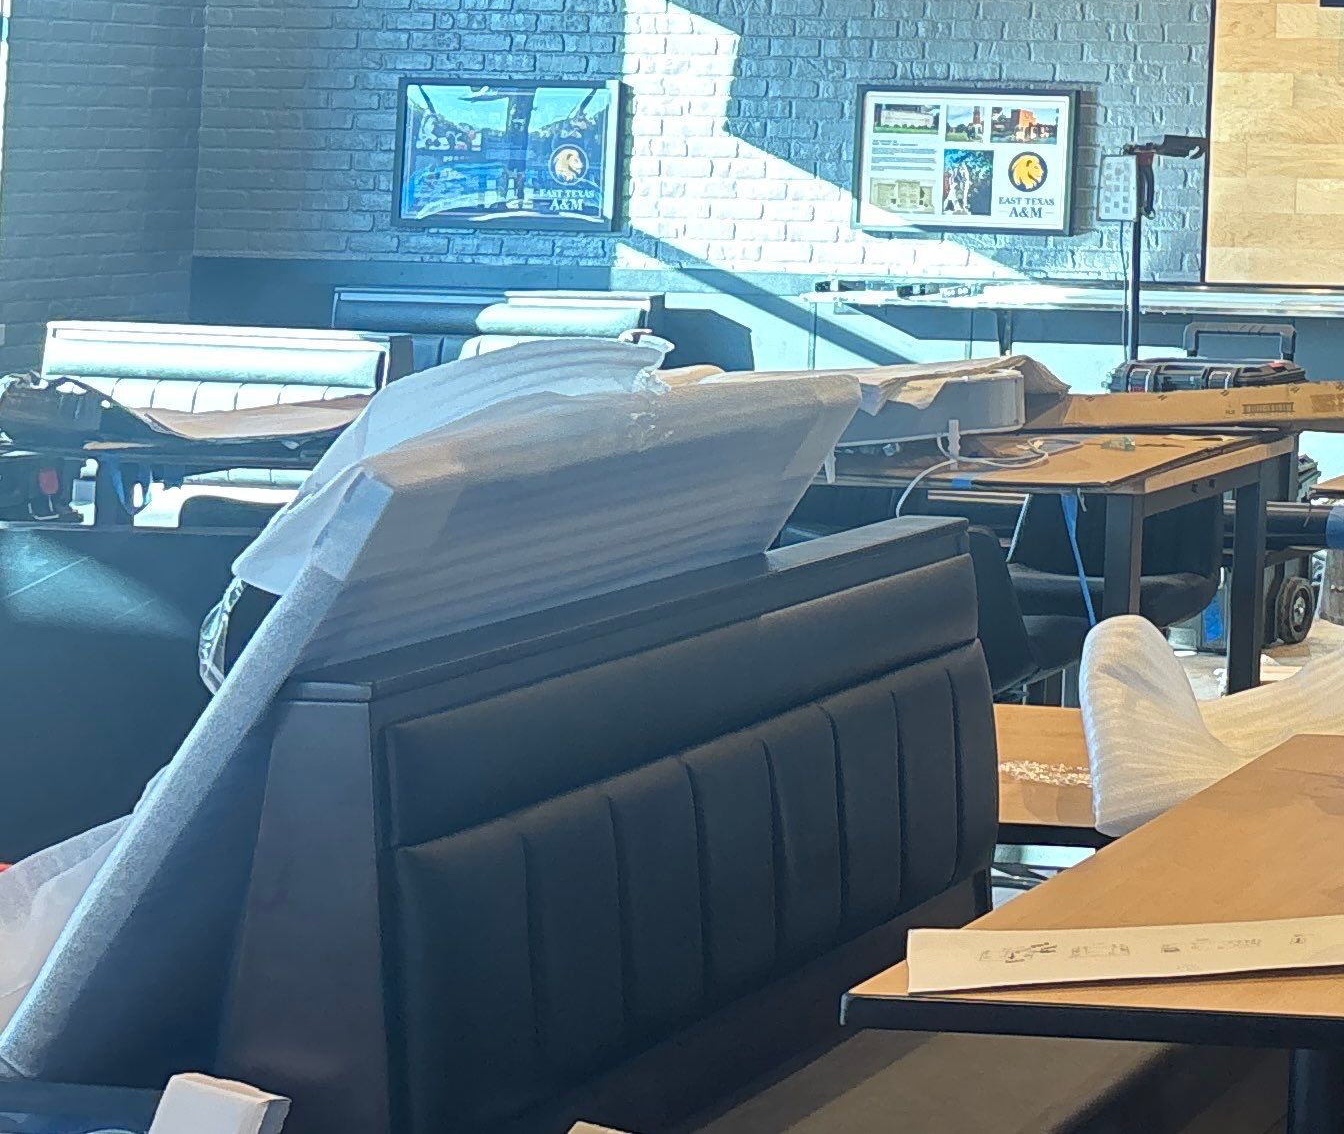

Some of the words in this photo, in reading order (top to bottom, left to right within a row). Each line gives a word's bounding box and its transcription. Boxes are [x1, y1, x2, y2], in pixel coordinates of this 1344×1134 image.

[539, 188, 564, 198] EAST
[549, 198, 584, 211] A&M
[998, 196, 1022, 205] EAST
[1024, 197, 1055, 206] TEXAS
[1008, 206, 1043, 219] A&M
